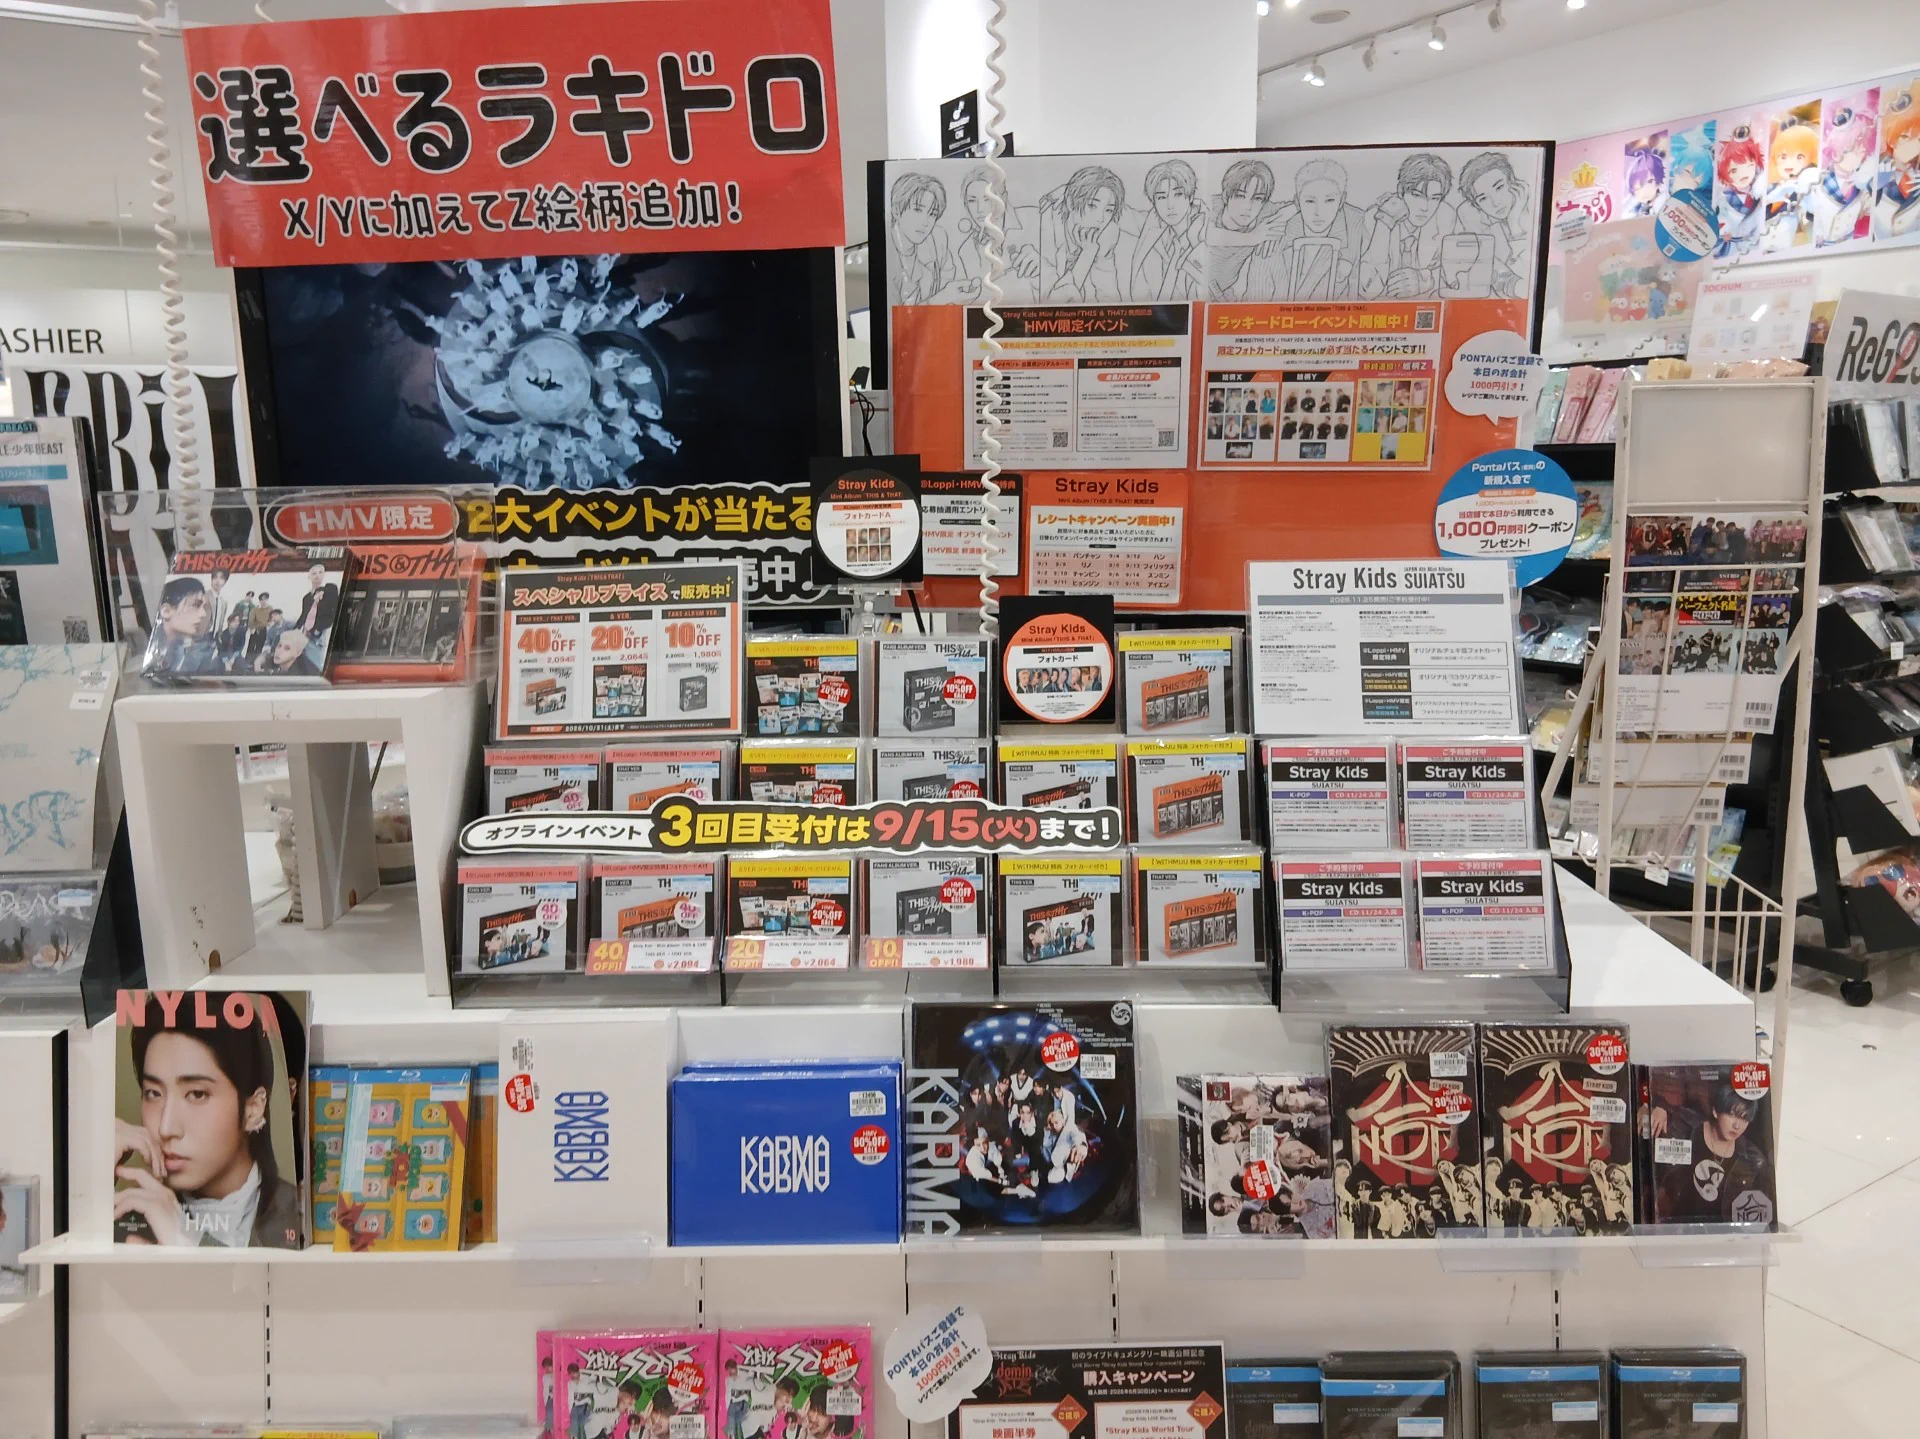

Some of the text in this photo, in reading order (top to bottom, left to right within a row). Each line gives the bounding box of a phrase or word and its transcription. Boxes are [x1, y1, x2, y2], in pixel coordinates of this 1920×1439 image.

[195, 51, 827, 183] 選べるラキドロ
[281, 178, 742, 246] X/Yに加えてZ絵柄追加!
[1024, 319, 1129, 333] HMV限定イベント
[1217, 314, 1409, 330] ラッキードローイベント開催中!
[1473, 368, 1527, 378] 本日のお会計
[838, 479, 894, 490] Stray Kids
[1056, 478, 1159, 494] Stray Kids
[1484, 474, 1531, 485] 新規入会で
[300, 505, 434, 532] HMV限定
[1438, 520, 1574, 540] 1,000円割引クーポン
[1480, 538, 1530, 548] プレゼント!
[1293, 566, 1397, 593] Stray Kids
[1404, 572, 1465, 589] SUIATSU
[512, 583, 731, 606] スペシャルプライスで販売中!
[1029, 624, 1086, 636] Stray Kids
[552, 640, 576, 652] OFF
[624, 636, 648, 648] OFF
[696, 634, 721, 646] OFF
[1038, 654, 1079, 664] フォトカード
[1290, 764, 1368, 781] Stray Kids
[1425, 764, 1506, 780] Stray Kids
[486, 804, 1110, 847] オフラインイベント 3回目受付は9/15(火)まで!
[1302, 882, 1384, 896] Stray Kids
[1440, 880, 1524, 896] Stray Kids
[593, 942, 623, 958] 40
[730, 940, 759, 958] 20
[872, 940, 896, 958] 10
[1044, 1041, 1074, 1057] 30%OFF
[1589, 1046, 1622, 1058] 30%OFF
[1734, 1070, 1767, 1082] 30%OFF
[907, 1068, 961, 1237] KARMA
[185, 1212, 230, 1232] HAN
[285, 1228, 297, 1240] 10
[908, 1330, 961, 1378] 本日のお会計
[1083, 1370, 1196, 1386] 購入キャンペーン
[992, 1428, 1036, 1438] 映画半券
